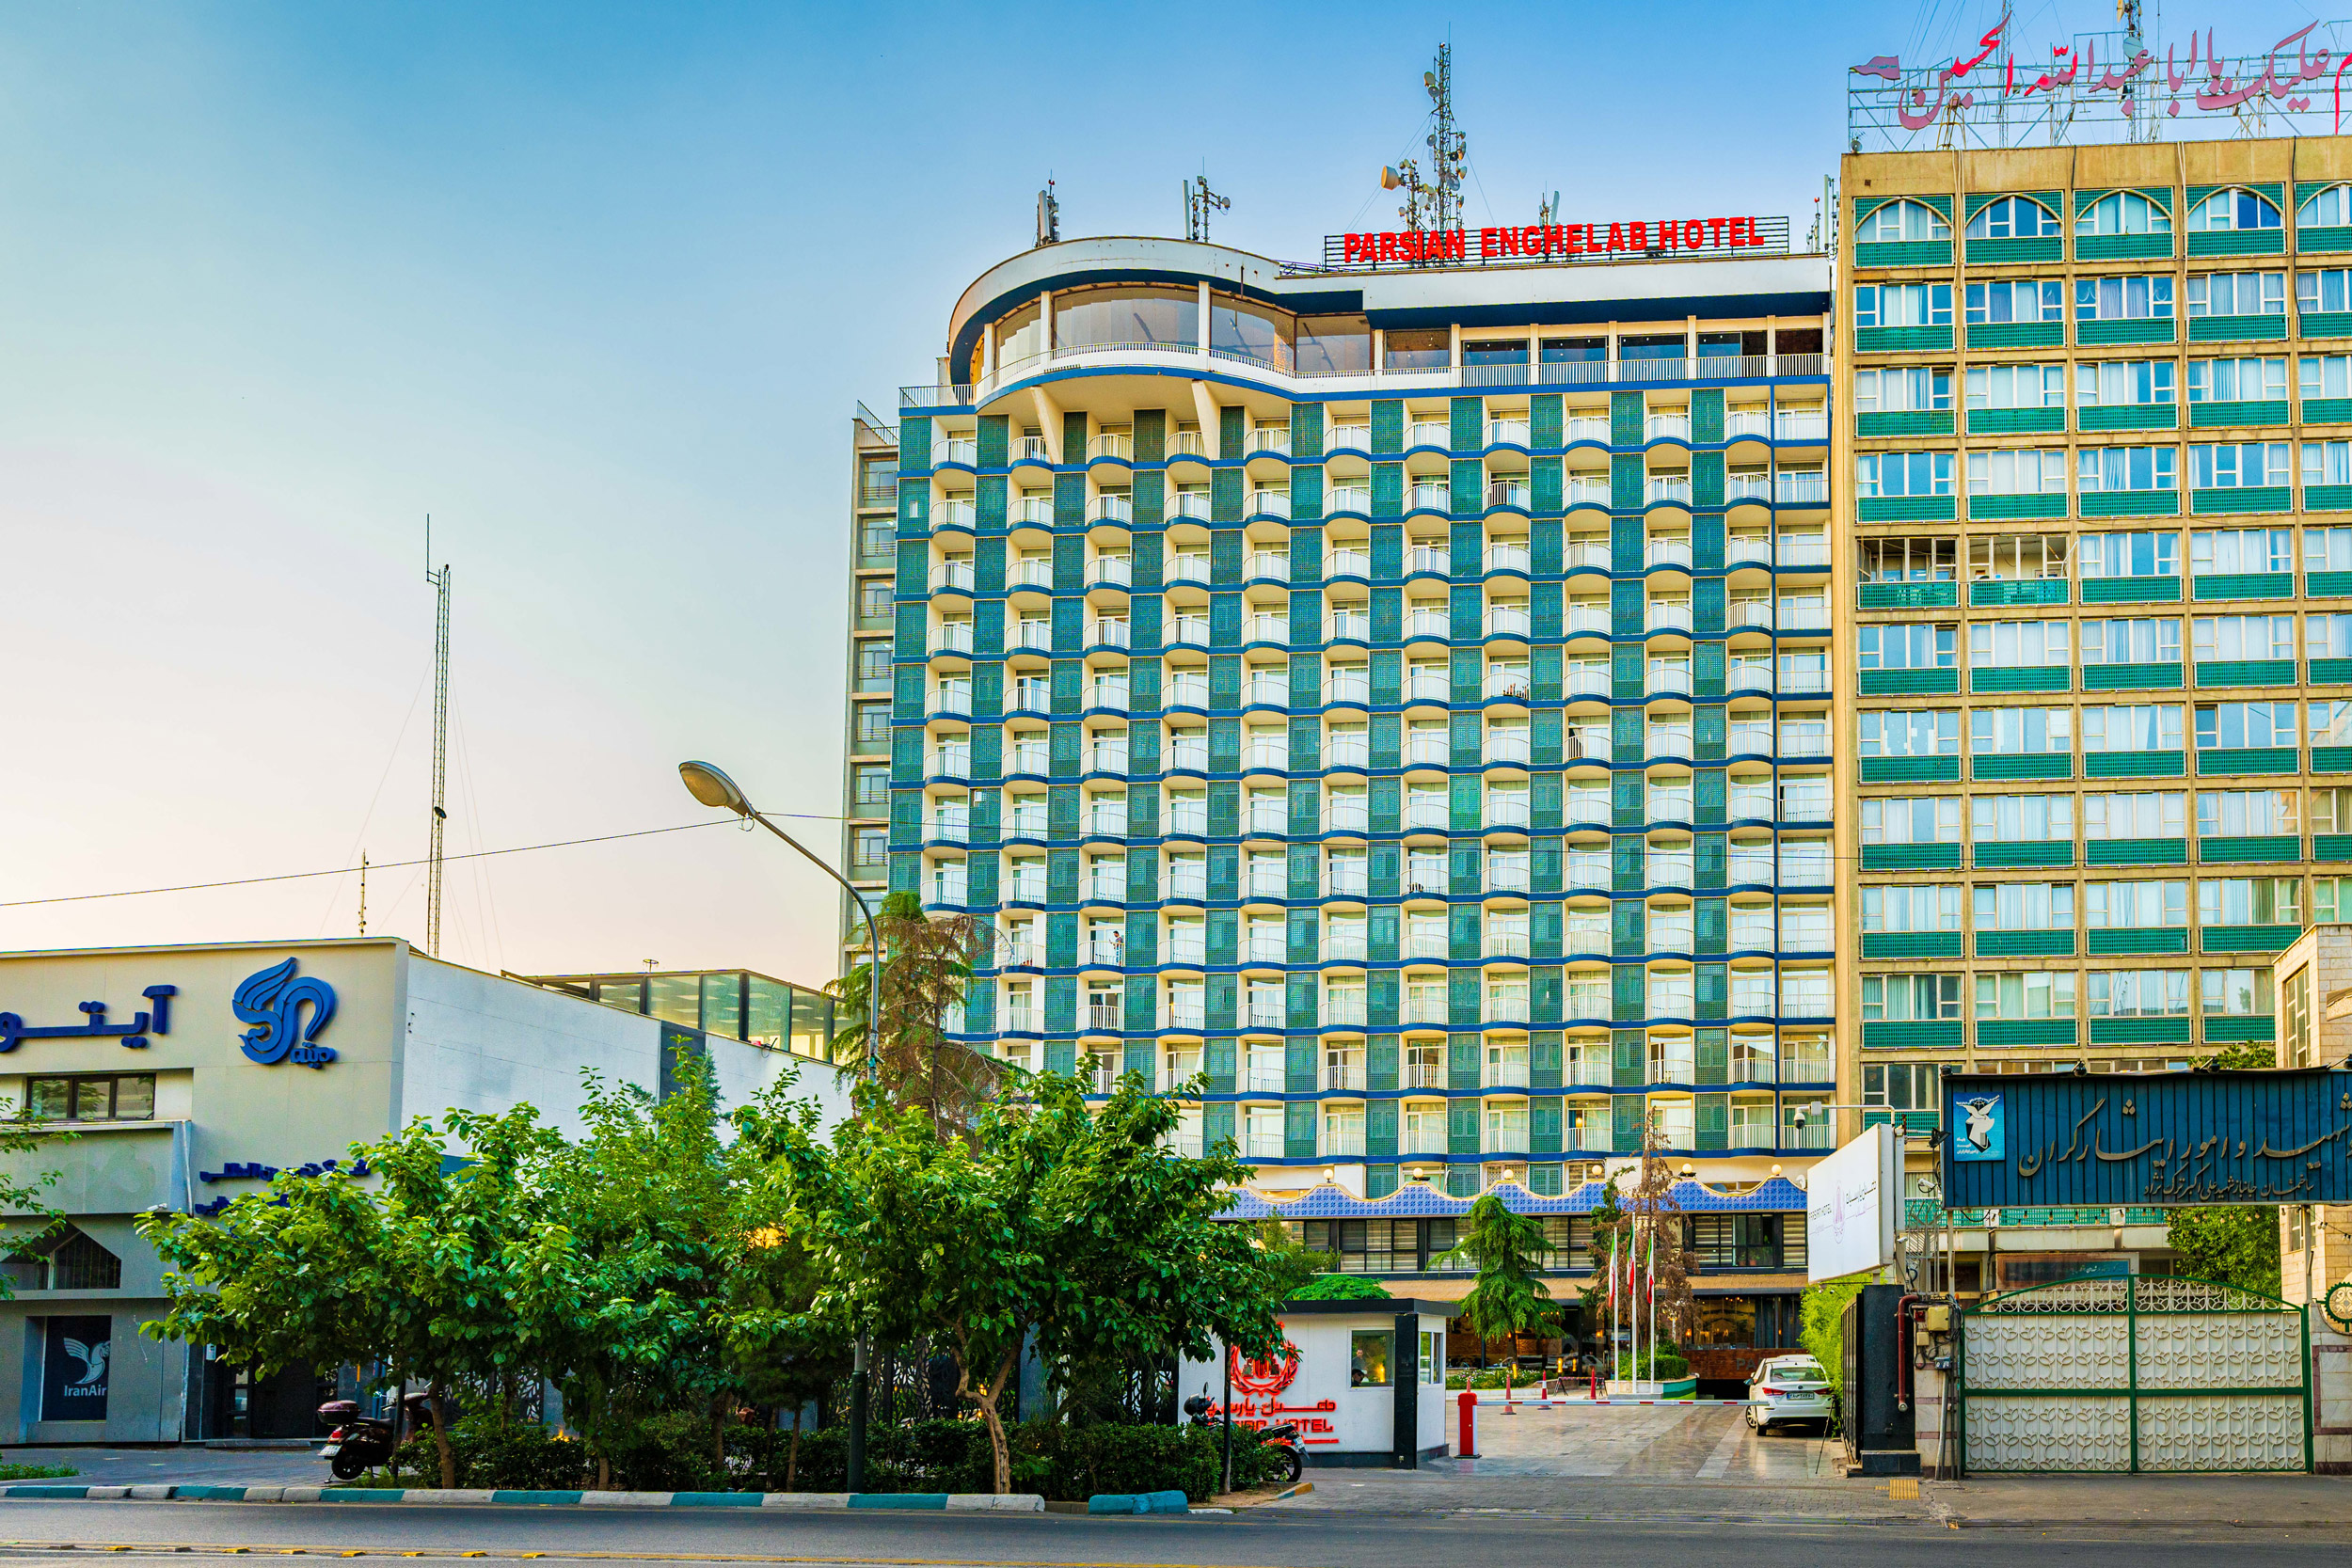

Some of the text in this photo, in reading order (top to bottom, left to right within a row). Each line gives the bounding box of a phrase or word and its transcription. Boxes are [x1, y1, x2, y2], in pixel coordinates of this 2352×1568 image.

[1344, 216, 1764, 262] PARSIAN ENGHELAB HOTEL
[2180, 1134, 2228, 1160] امور
[2234, 1140, 2248, 1158] و
[64, 1385, 107, 1397] IranAir
